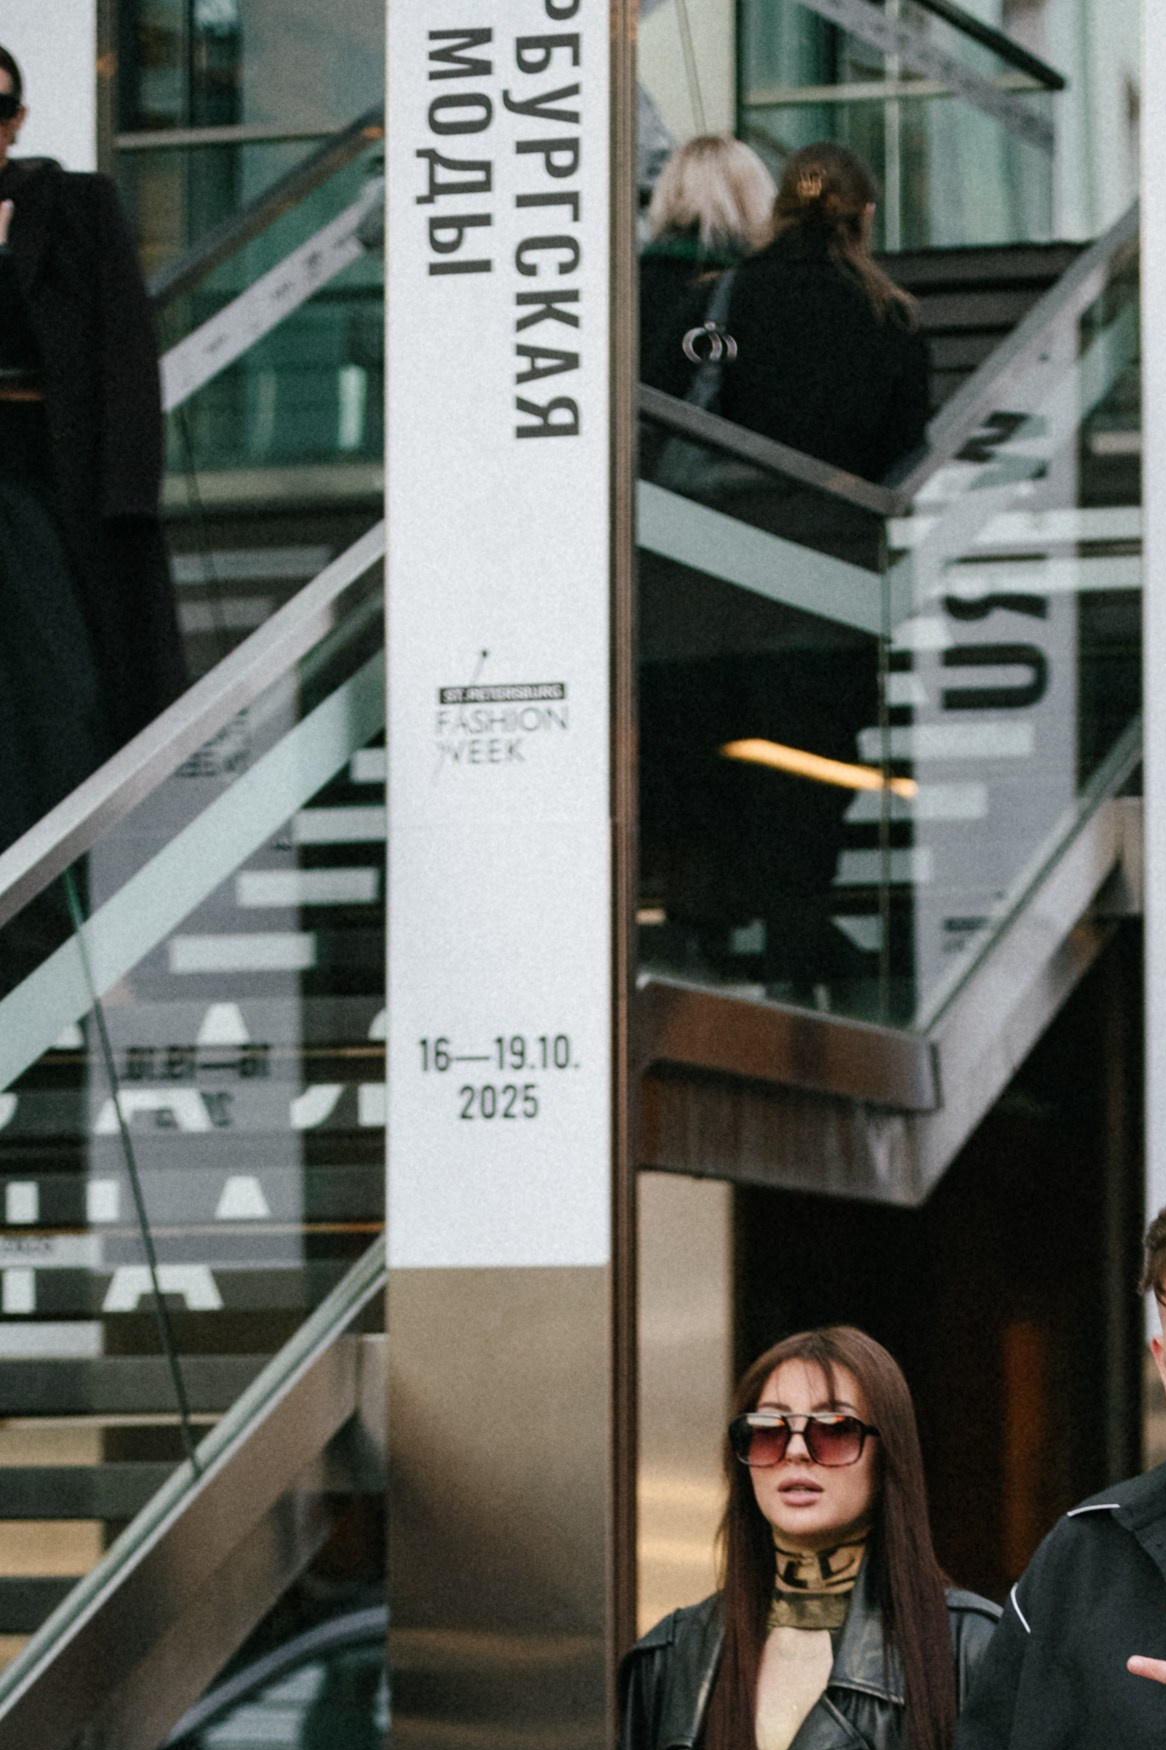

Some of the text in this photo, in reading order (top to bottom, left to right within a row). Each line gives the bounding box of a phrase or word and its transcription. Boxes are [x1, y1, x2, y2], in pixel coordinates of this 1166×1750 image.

[415, 26, 495, 278] МОДЫ
[436, 705, 569, 735] FASHION
[436, 737, 527, 765] WEEK
[459, 1083, 539, 1120] 2025
